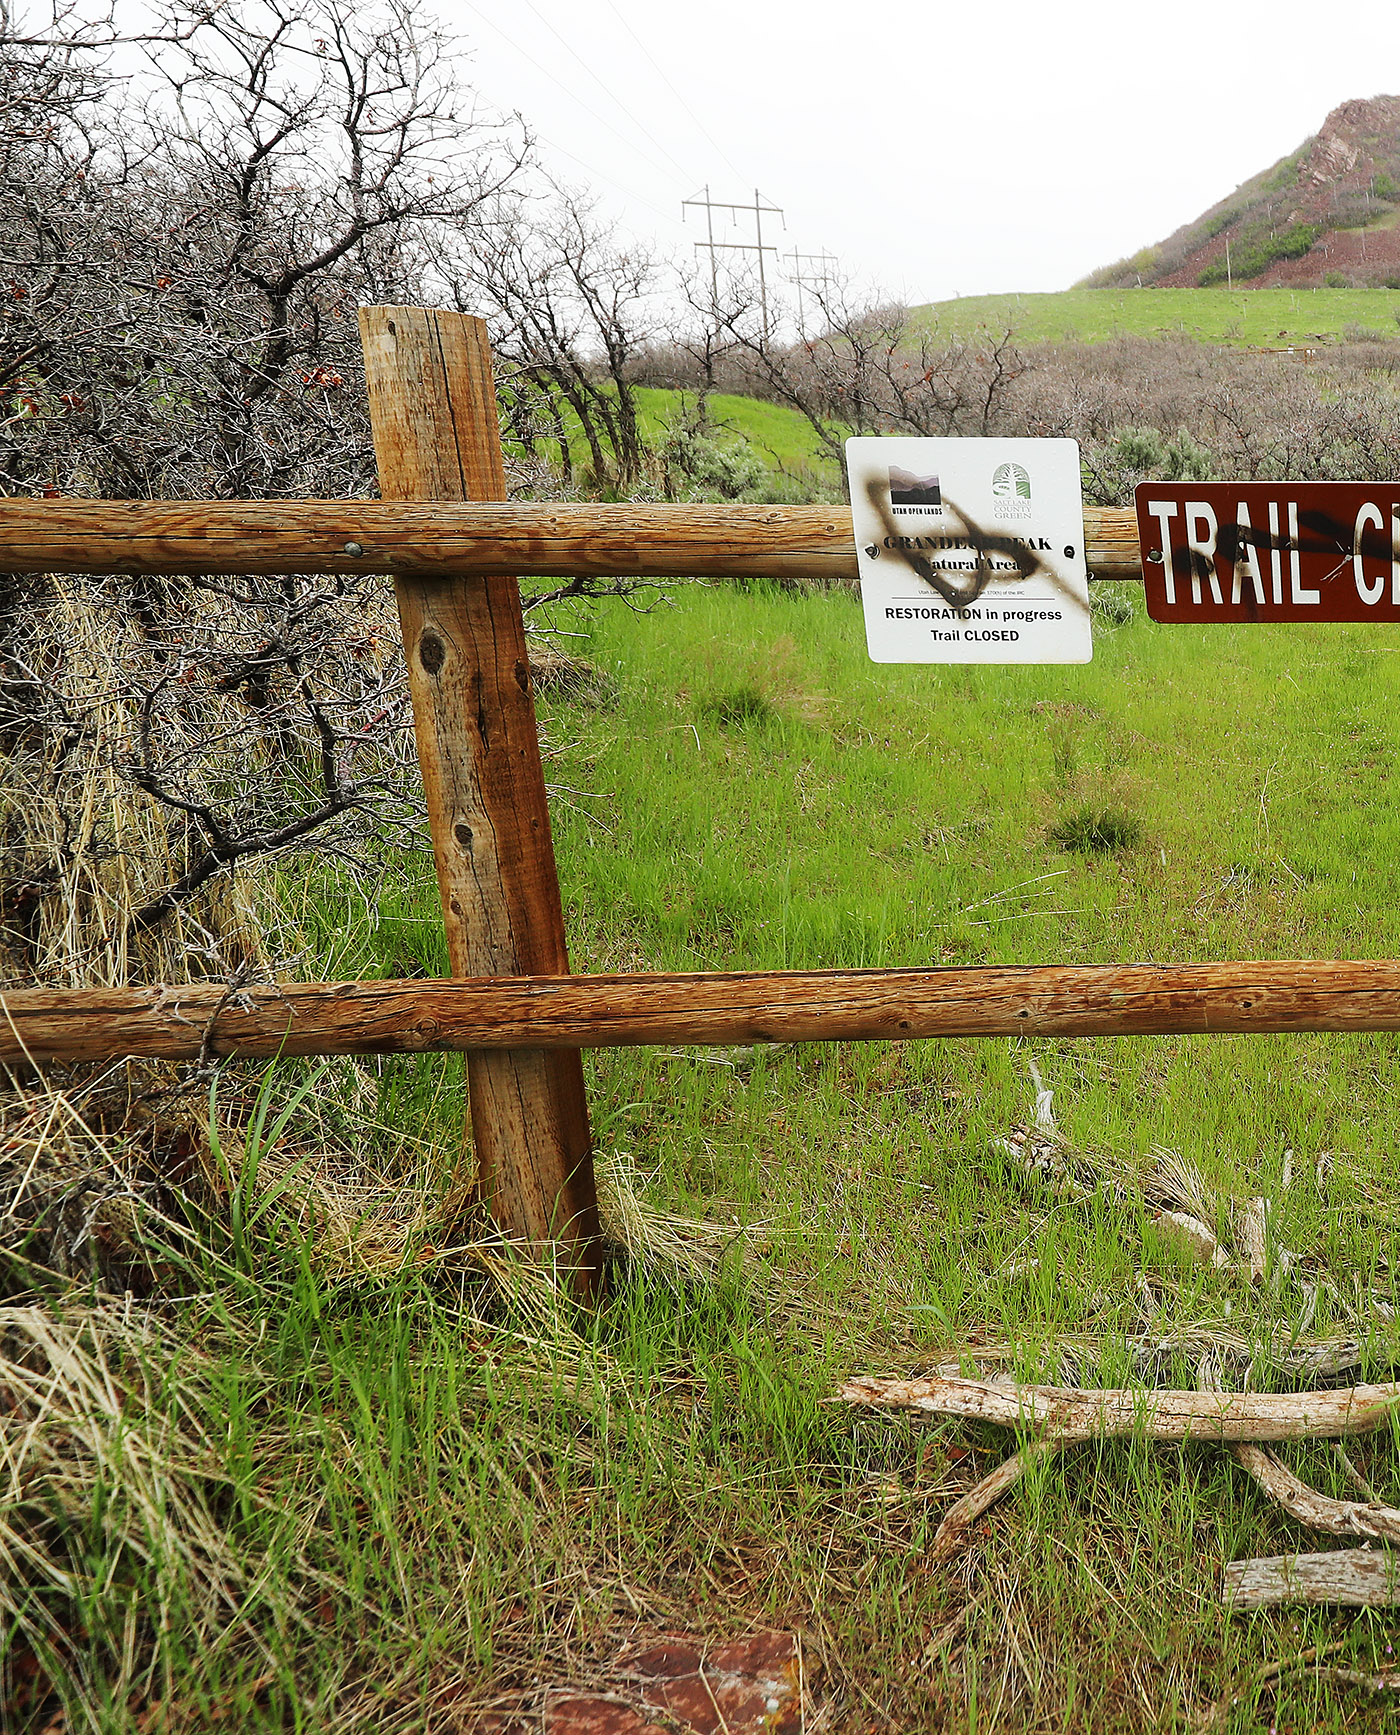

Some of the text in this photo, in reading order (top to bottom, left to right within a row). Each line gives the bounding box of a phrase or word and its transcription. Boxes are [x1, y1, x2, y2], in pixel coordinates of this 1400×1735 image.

[892, 507, 908, 515] UTAH
[908, 507, 923, 515] OPEN
[883, 536, 996, 550] GRANDE
[1147, 501, 1321, 605] TRAIL
[984, 558, 1022, 570] Area
[885, 608, 1063, 623] RESTORATION in progress
[931, 630, 1020, 641] Trail CLOSED
